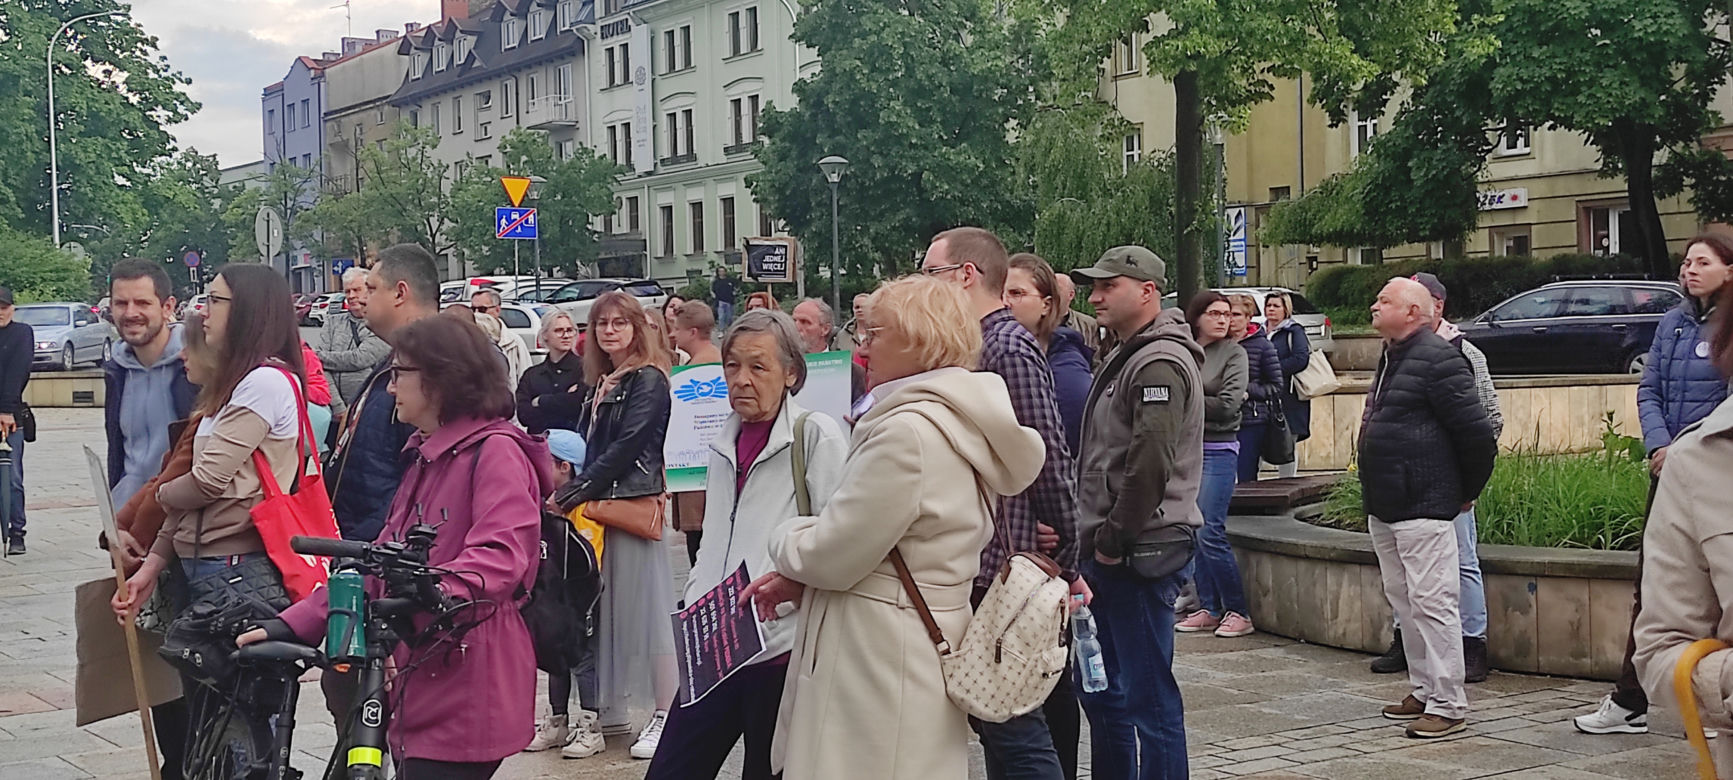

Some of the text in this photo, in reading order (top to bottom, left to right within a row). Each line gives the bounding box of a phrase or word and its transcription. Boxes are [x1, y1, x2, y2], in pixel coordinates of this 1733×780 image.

[600, 17, 631, 40] HOTEL
[774, 246, 786, 255] ANI
[762, 255, 786, 263] JEDNEJ
[762, 262, 785, 272] WIĘCEJ
